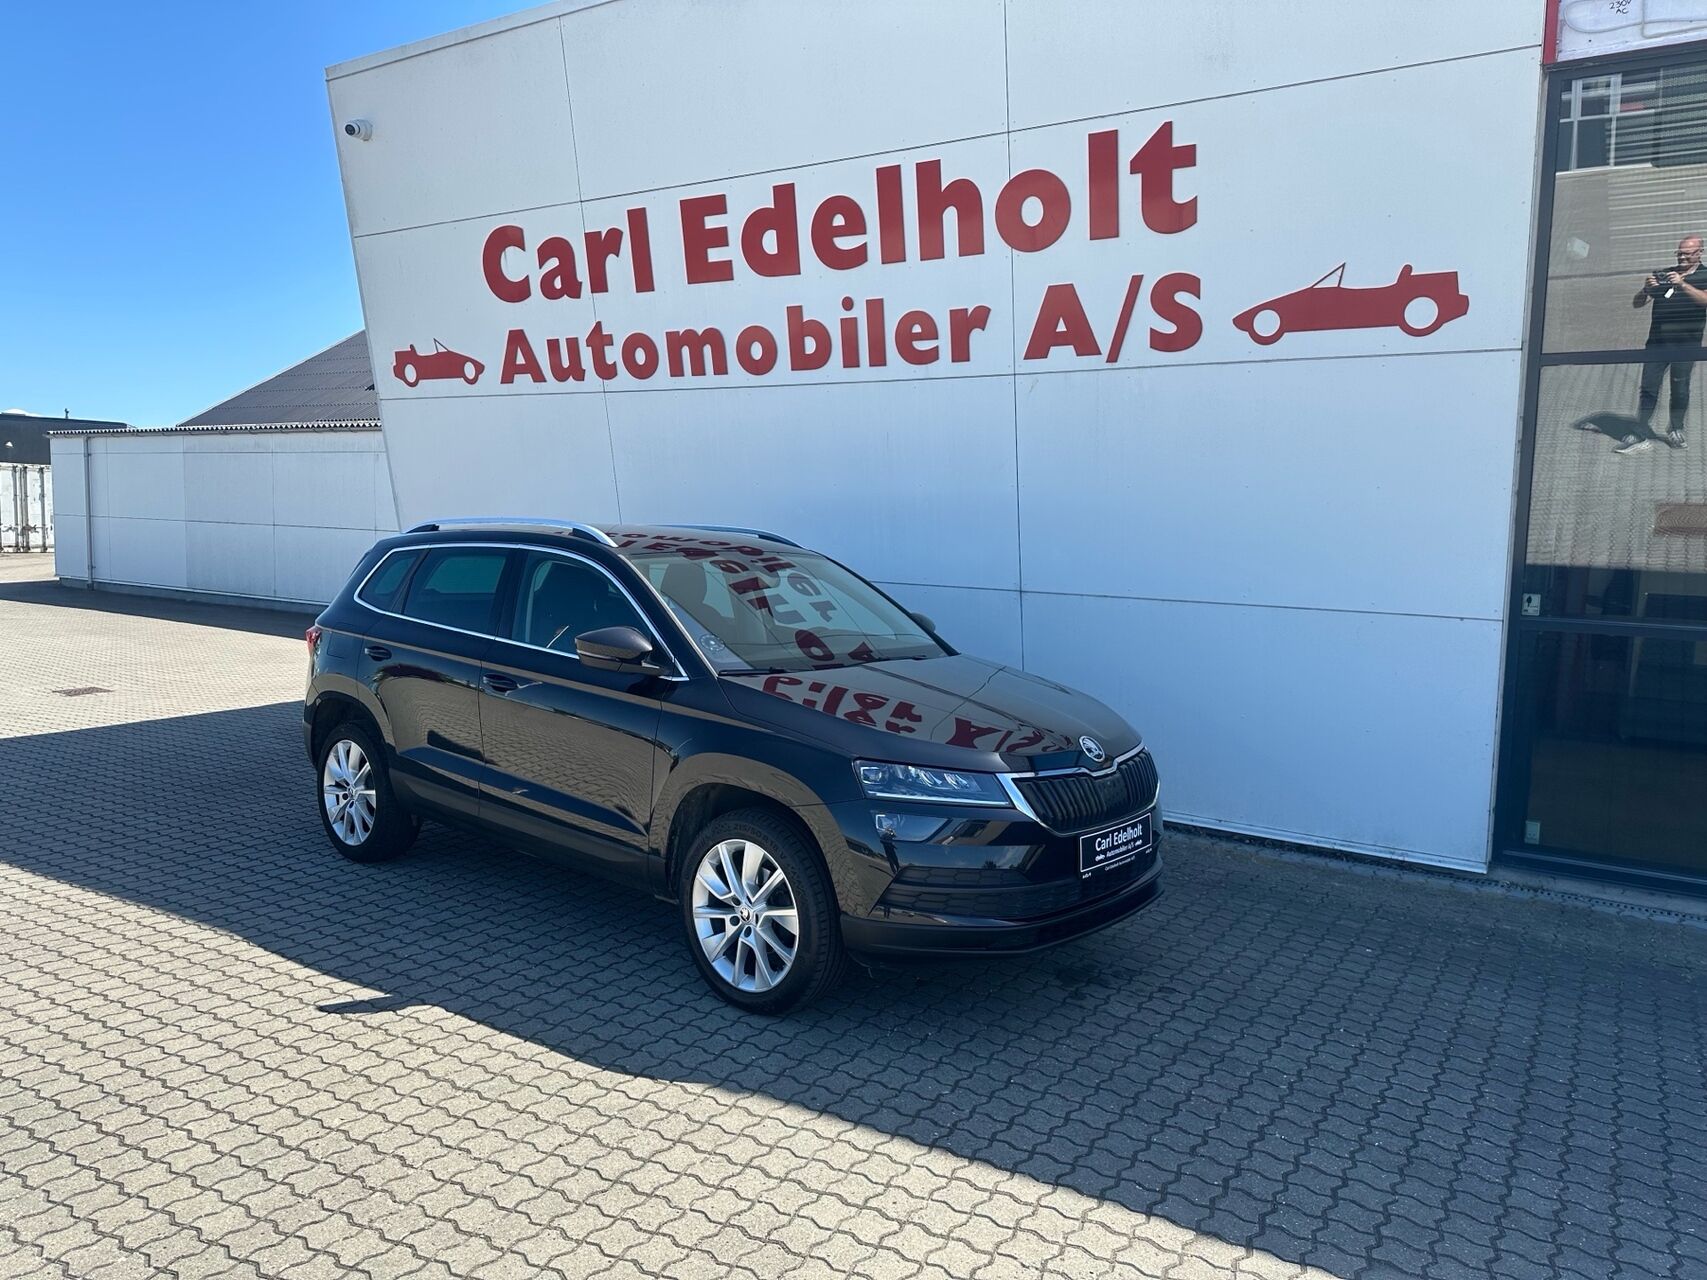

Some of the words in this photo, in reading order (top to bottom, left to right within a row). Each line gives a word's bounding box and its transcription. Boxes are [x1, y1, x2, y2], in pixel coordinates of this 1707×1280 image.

[482, 207, 655, 303] Carl
[680, 122, 1198, 285] Edelholt
[500, 296, 991, 384] Automobiler
[1024, 271, 1203, 364] A/S
[1095, 833, 1112, 851] Carl
[1113, 823, 1142, 845] Edelholt
